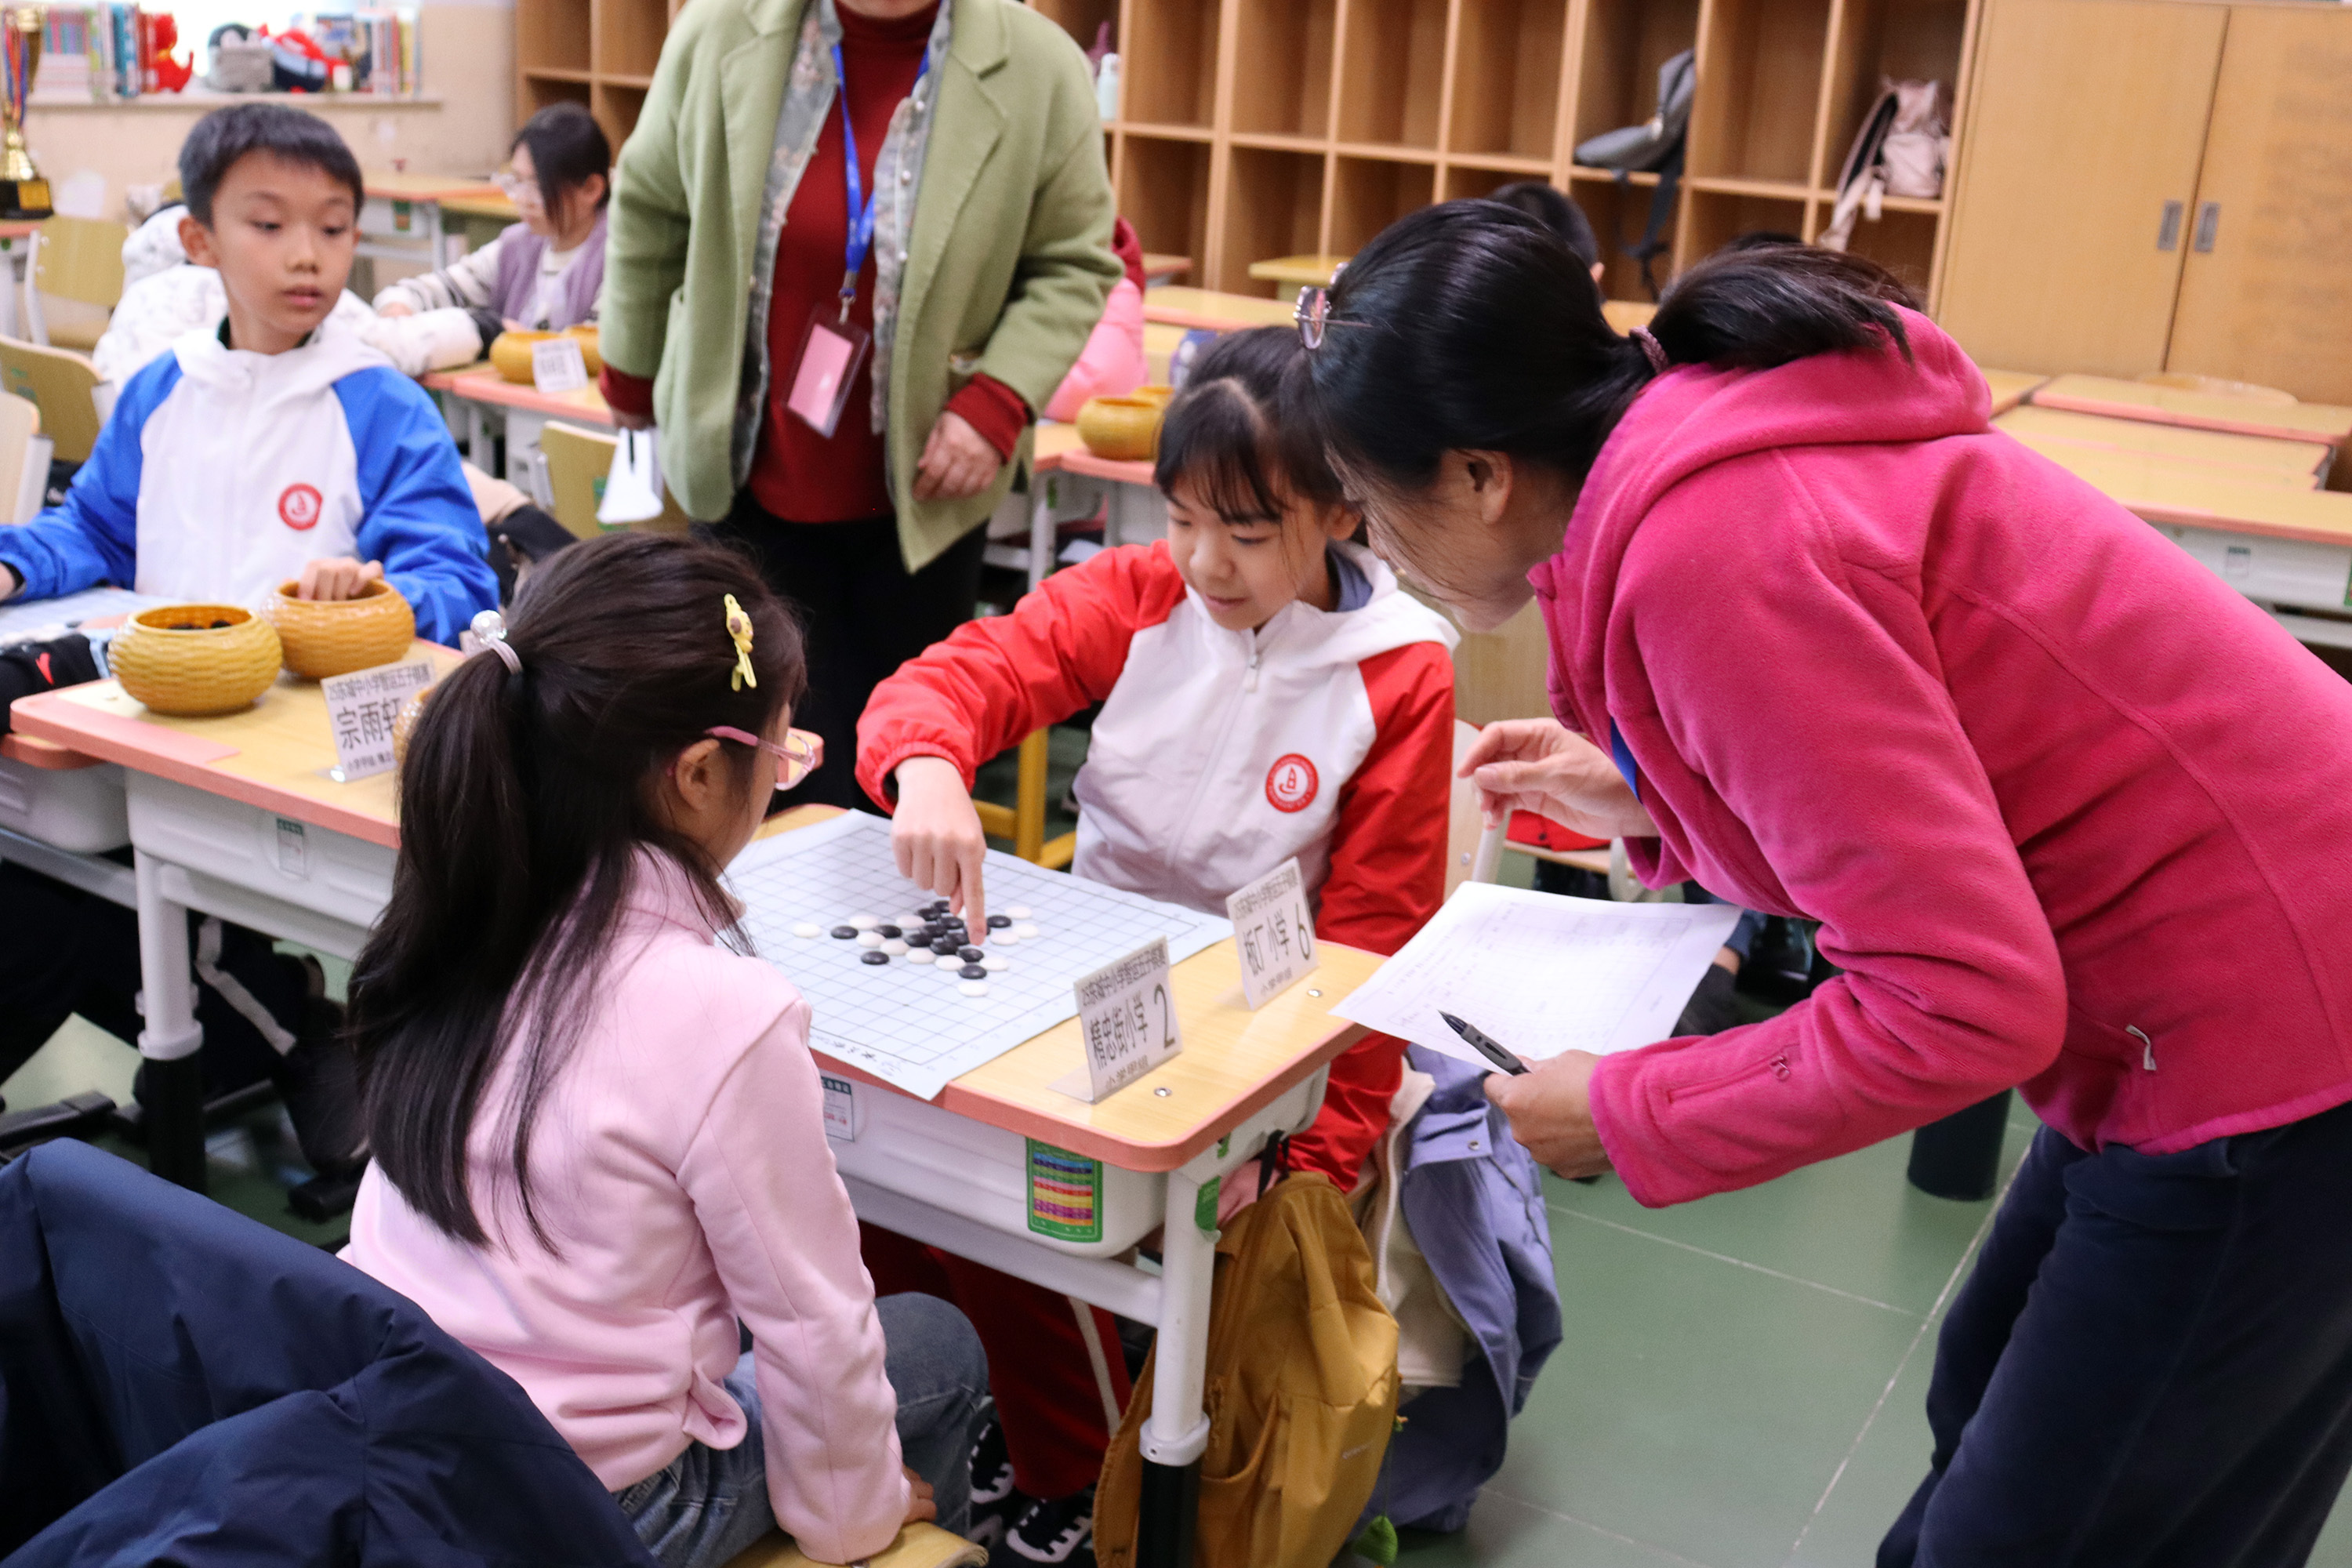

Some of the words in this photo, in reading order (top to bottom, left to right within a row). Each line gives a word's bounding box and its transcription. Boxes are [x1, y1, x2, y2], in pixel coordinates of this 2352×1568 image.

[337, 698, 401, 750] 宗雨轩
[1243, 909, 1290, 977] 板厂小学
[1295, 902, 1311, 960] 6
[1089, 992, 1149, 1071] 精忠街小学
[1154, 982, 1176, 1049] 2
